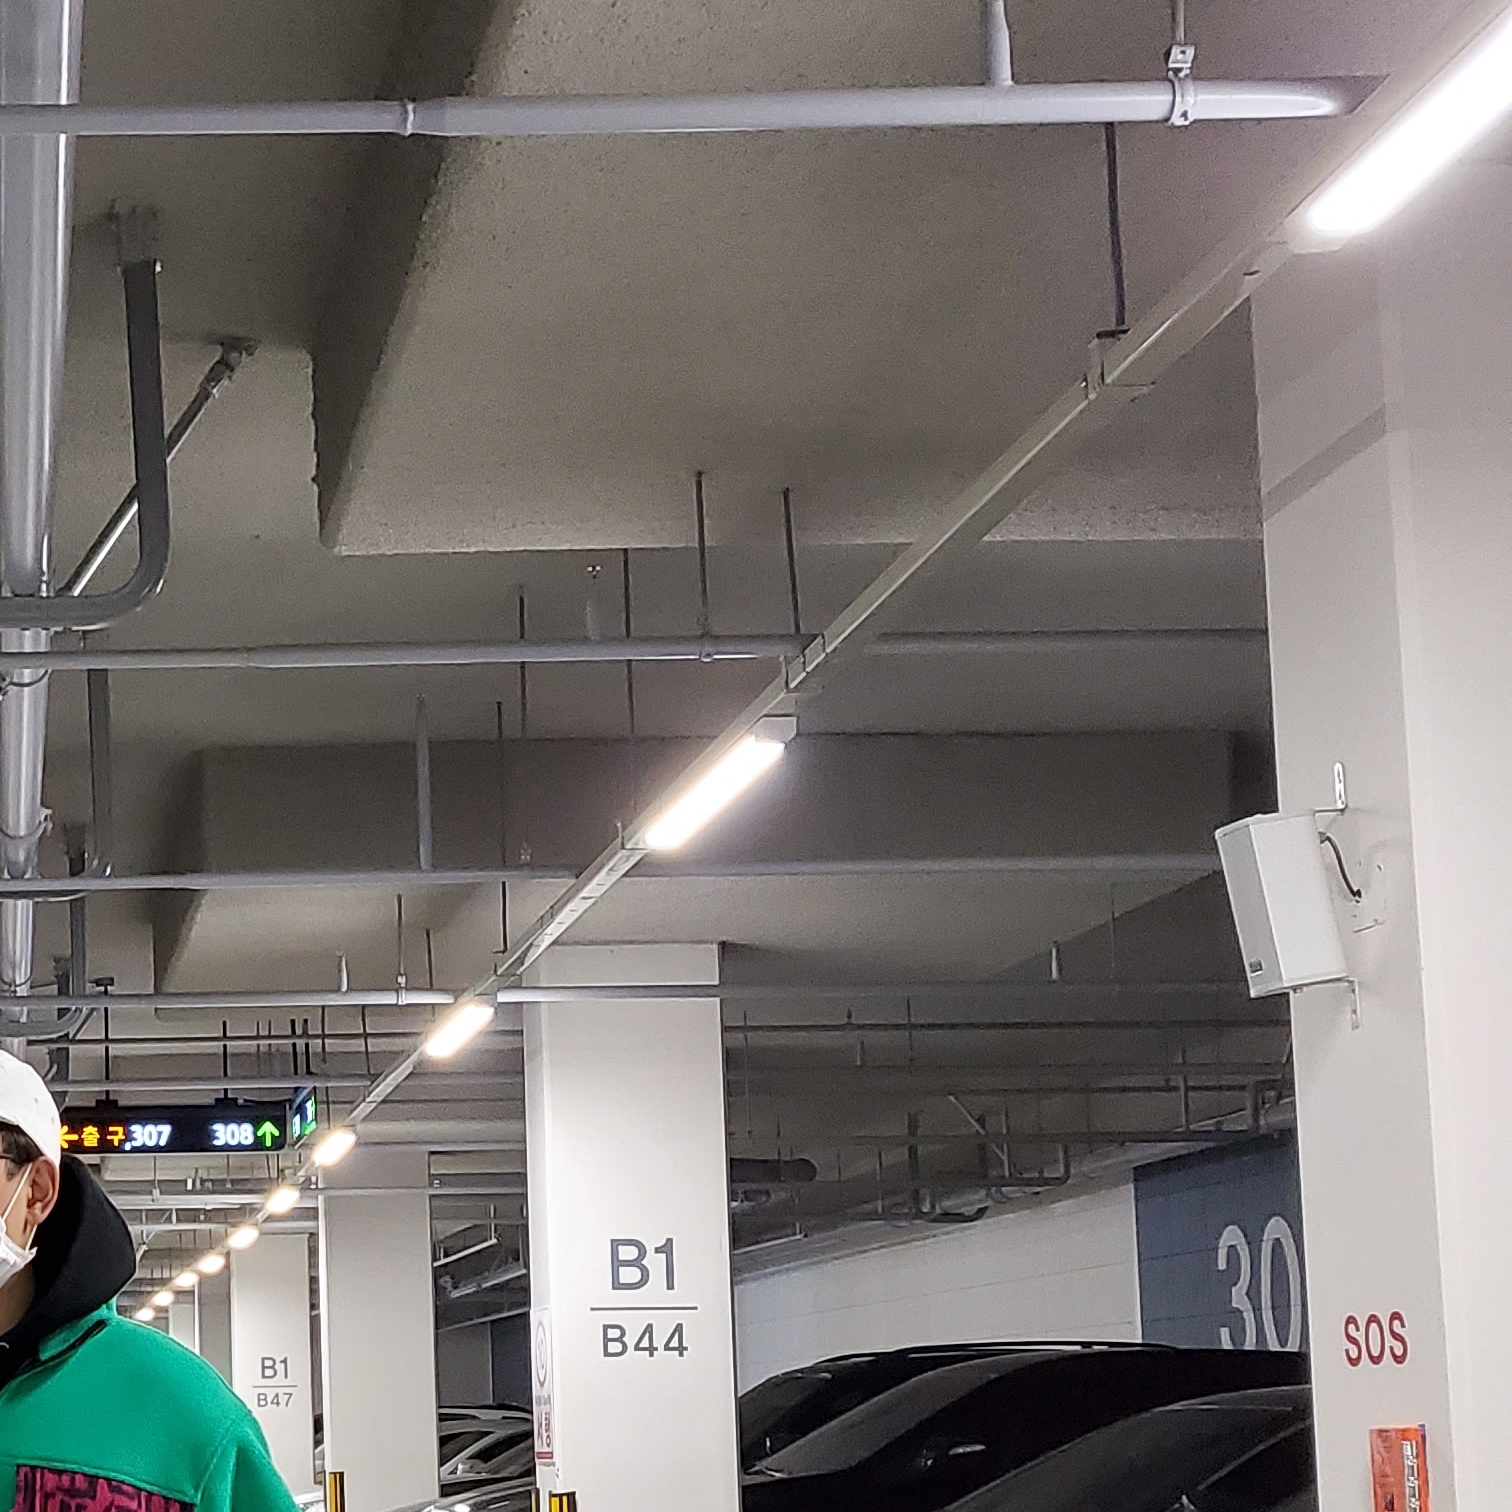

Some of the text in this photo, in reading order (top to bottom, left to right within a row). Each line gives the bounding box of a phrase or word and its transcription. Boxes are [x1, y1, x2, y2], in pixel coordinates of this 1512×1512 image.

[211, 1122, 255, 1146] 308
[610, 1237, 675, 1291] B1
[602, 1322, 689, 1358] B44
[1344, 1310, 1408, 1367] SOS
[261, 1356, 289, 1380] B1
[257, 1392, 294, 1408] B47
